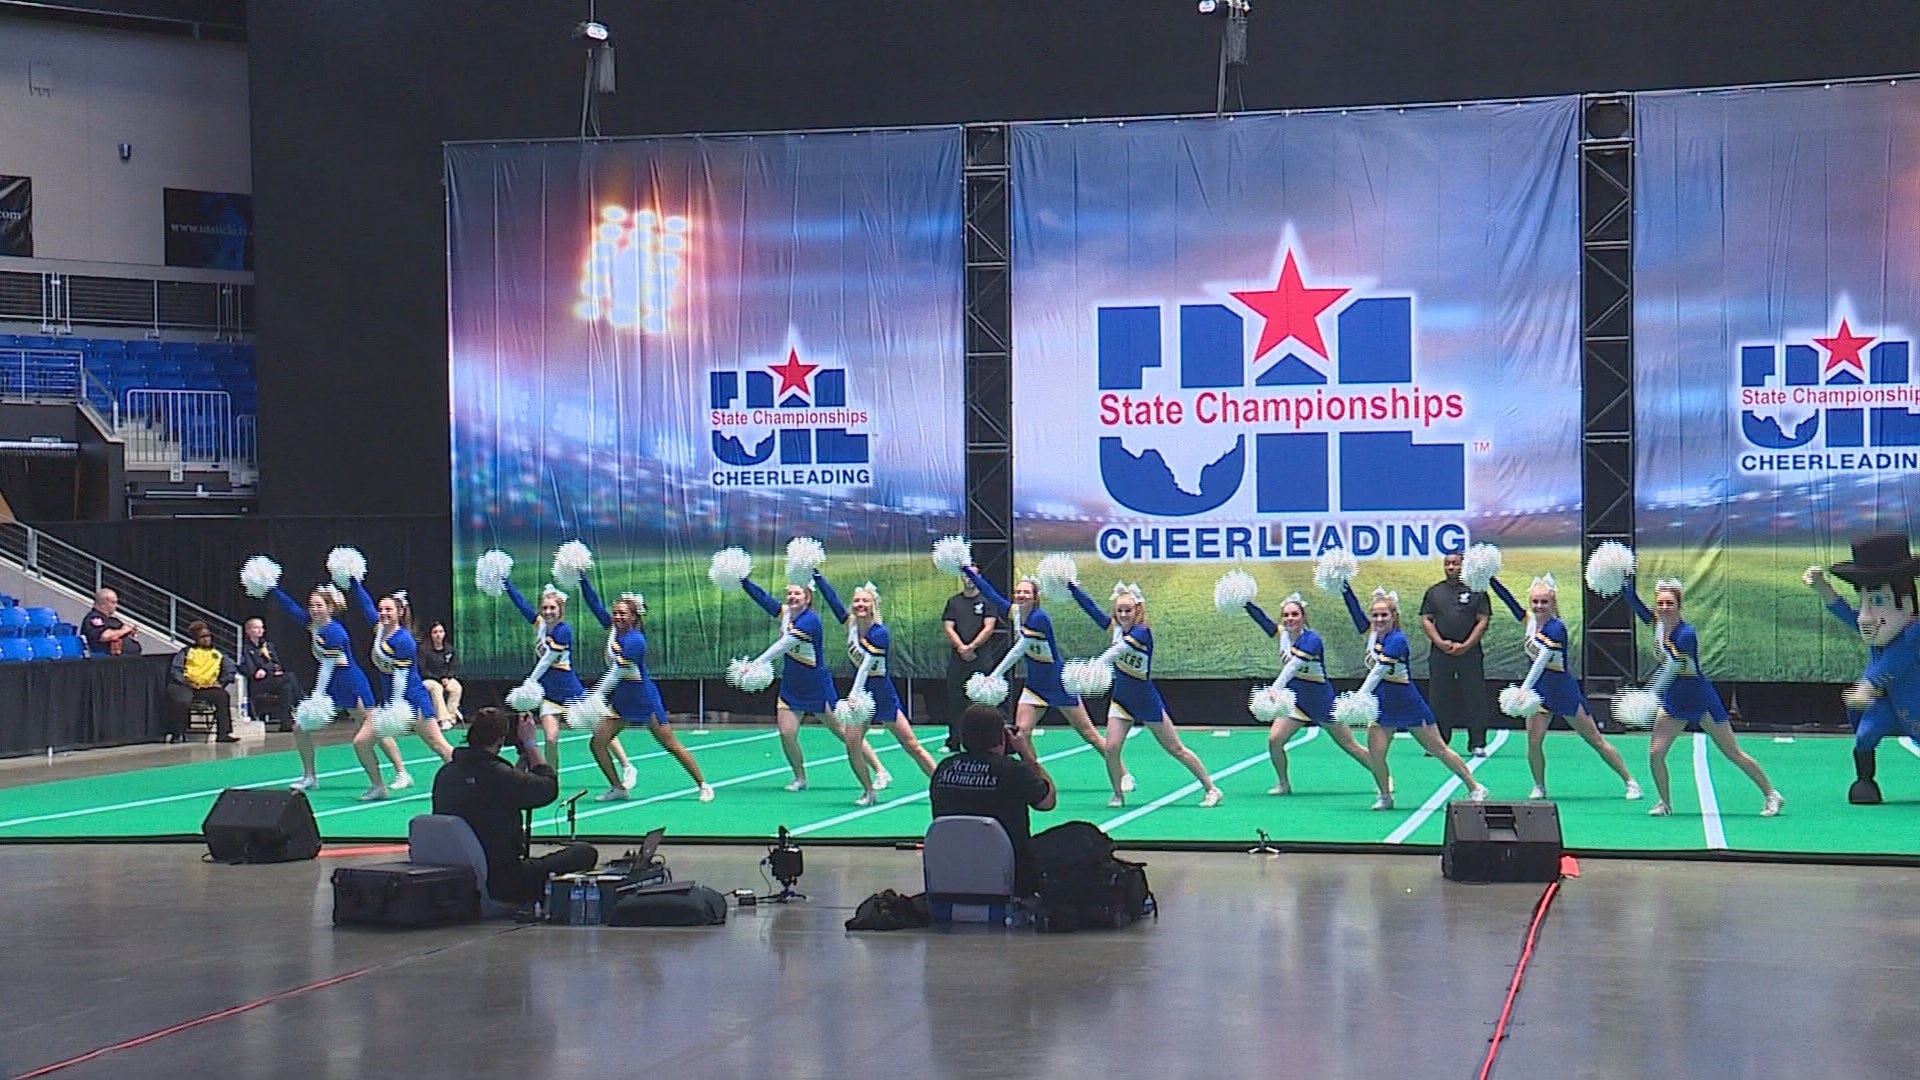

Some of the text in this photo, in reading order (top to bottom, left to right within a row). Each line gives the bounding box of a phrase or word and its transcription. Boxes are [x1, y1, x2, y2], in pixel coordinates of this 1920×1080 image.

[1742, 388, 1786, 405] State
[711, 408, 868, 427] State Championships
[1100, 388, 1463, 429] State Championships
[1473, 442, 1490, 453] TM
[1742, 452, 1918, 470] CHEERLEADIN
[712, 469, 870, 486] CHEERLEADING
[1100, 523, 1466, 560] CHEERLEADING
[952, 760, 990, 773] Action
[938, 768, 998, 786] Moments
